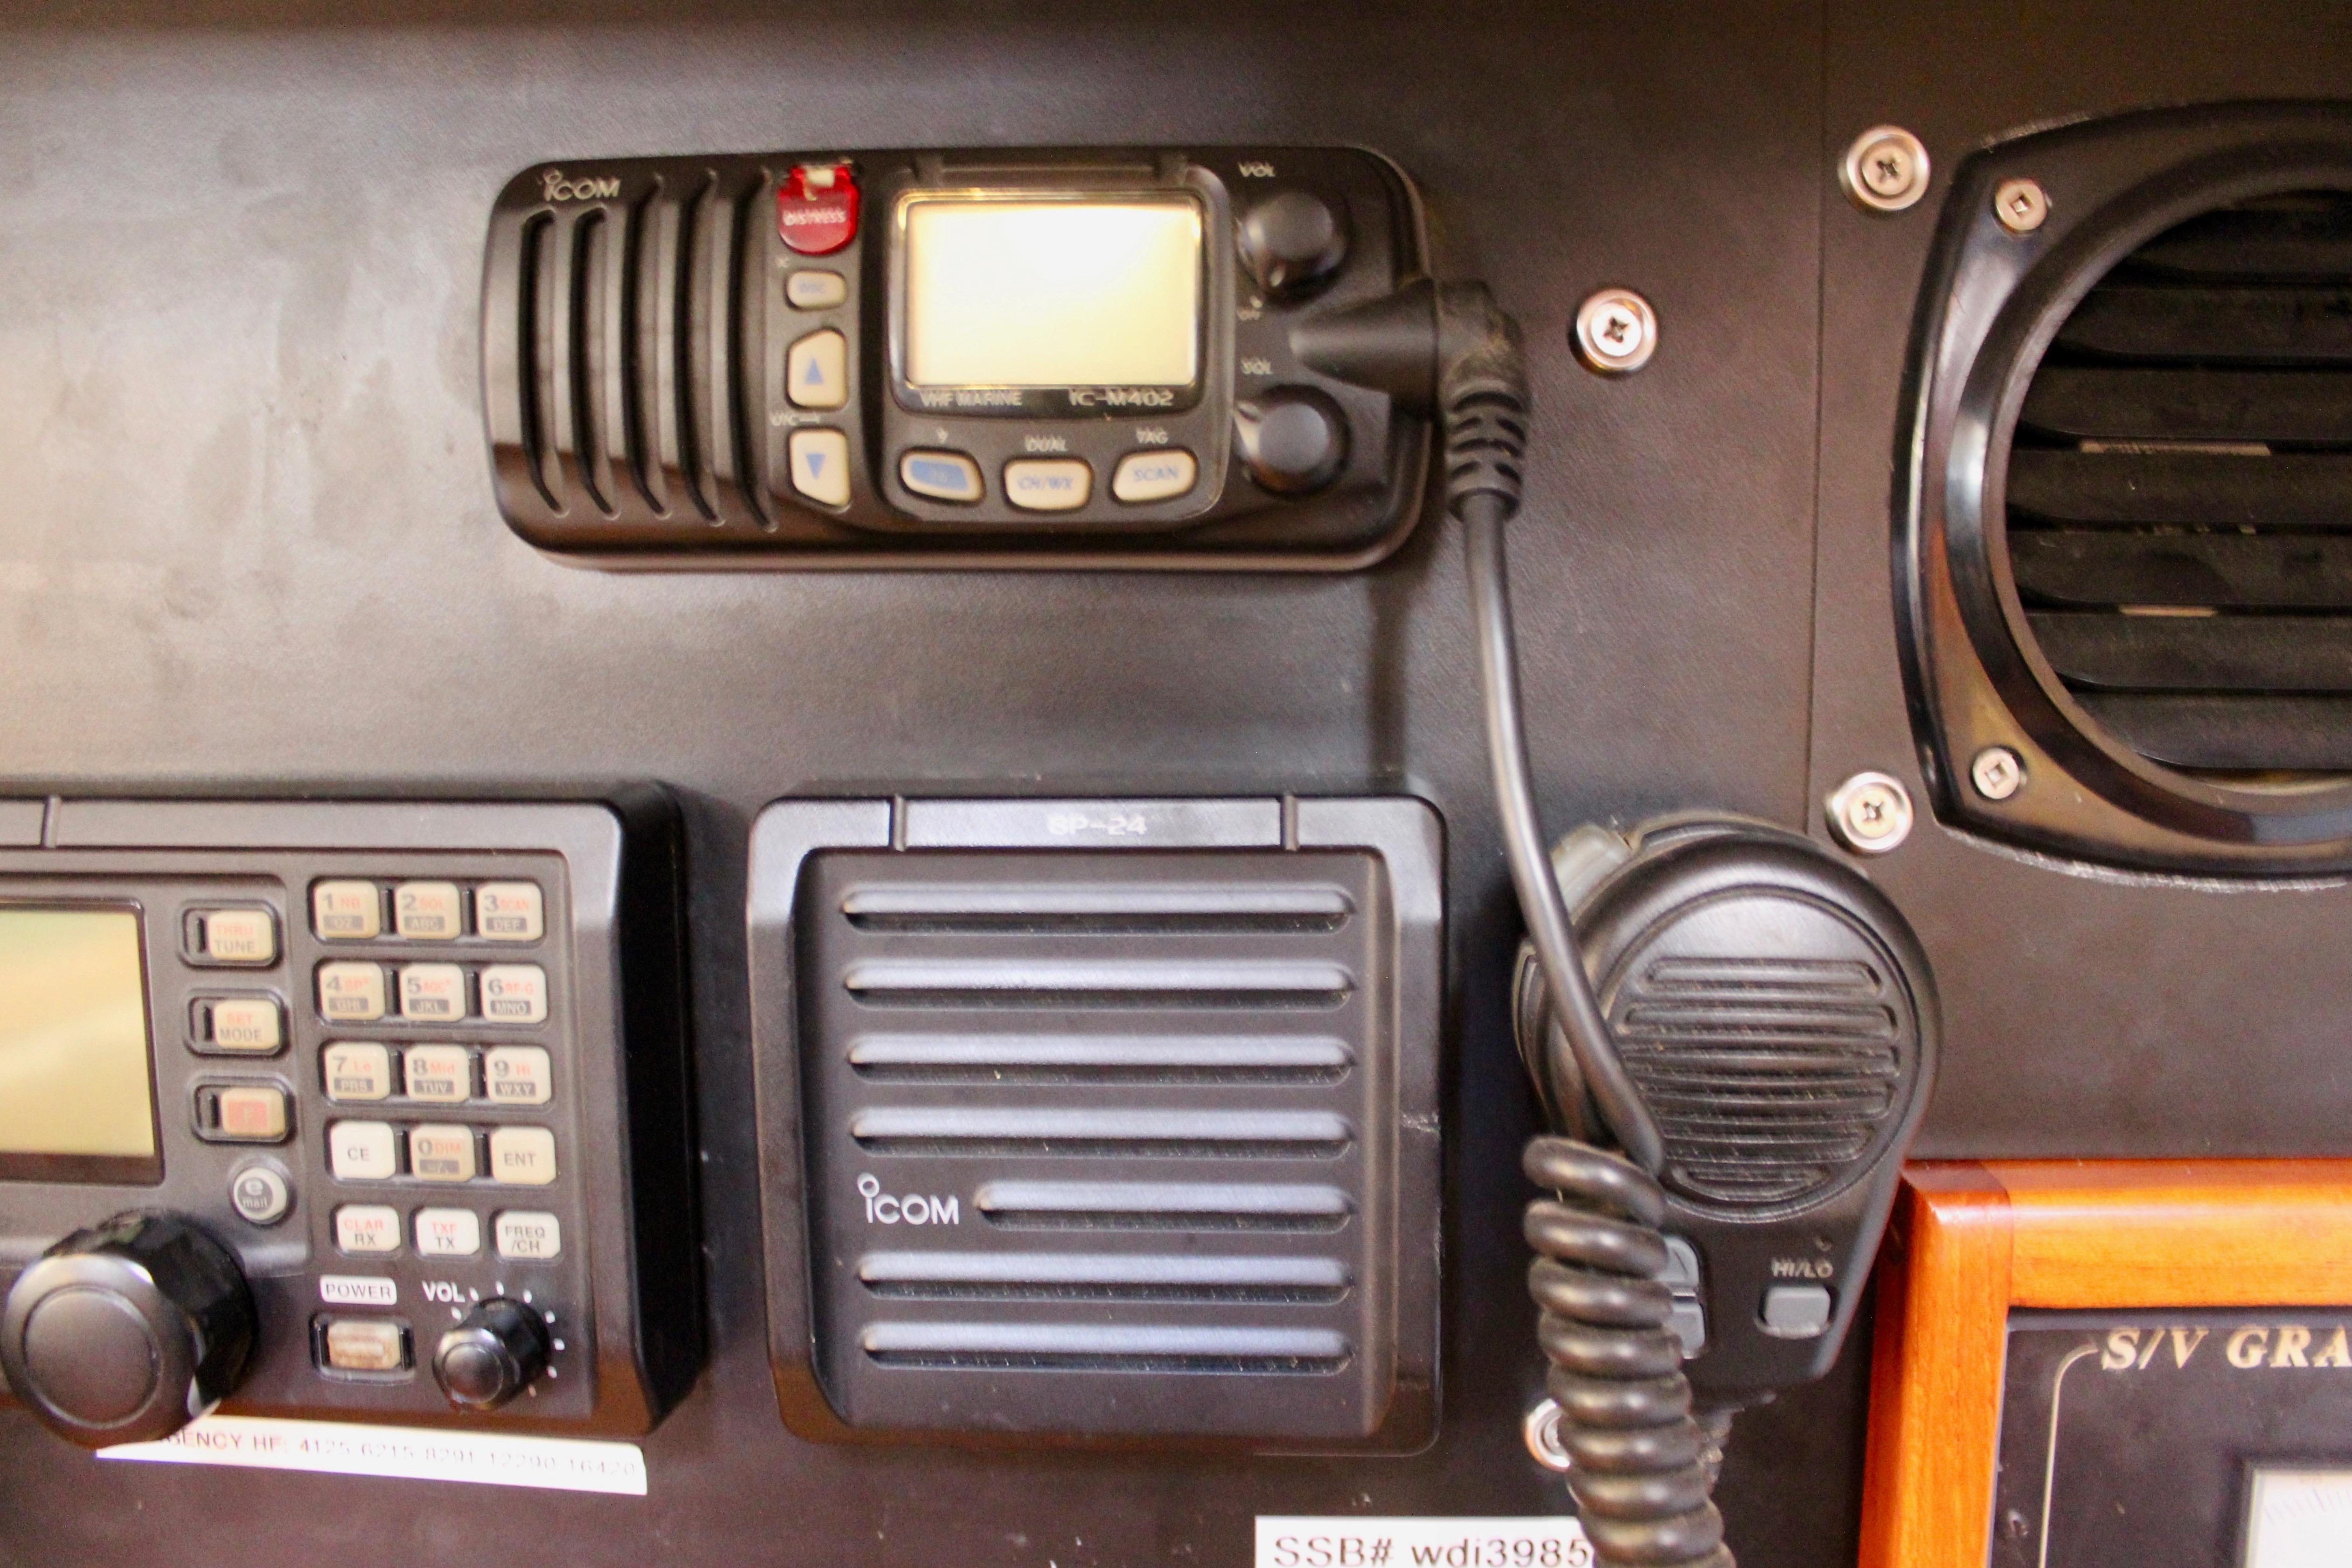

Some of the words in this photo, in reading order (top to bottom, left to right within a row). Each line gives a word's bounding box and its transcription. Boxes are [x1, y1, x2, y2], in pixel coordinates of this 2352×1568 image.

[782, 208, 846, 226] DISTRESS
[919, 390, 954, 406] VHF
[956, 390, 1022, 406] MARINE
[1068, 388, 1174, 406] IC-M402
[1025, 434, 1068, 452] DUAL
[1136, 426, 1168, 444] TAG
[1133, 465, 1179, 482] SCAN
[1017, 475, 1075, 490] CH/WX
[323, 894, 334, 911] 1
[340, 897, 361, 909] NB
[402, 894, 416, 912] 2
[484, 894, 499, 912] 3
[499, 897, 529, 911] SCAN
[215, 924, 254, 937] THRU
[410, 918, 438, 931] ABC
[493, 919, 520, 931] DEF
[215, 940, 256, 953] TUNE
[326, 976, 342, 992] 4
[407, 977, 422, 994] 5
[488, 978, 504, 995] 6
[336, 999, 362, 1011] GHI
[417, 1000, 442, 1013] JKL
[495, 1002, 527, 1014] MNO
[227, 1012, 253, 1024] SET
[220, 1029, 263, 1042] MODE
[333, 1055, 347, 1073] 7
[413, 1057, 428, 1075] 8
[431, 1060, 456, 1075] Mid
[494, 1059, 510, 1078] 9
[340, 1079, 367, 1092] PRS
[421, 1081, 448, 1094] TUV
[500, 1082, 531, 1096] WXY
[347, 1147, 370, 1162] CE
[418, 1139, 433, 1157] 0
[435, 1141, 462, 1156] DIM
[504, 1152, 537, 1167] ENT
[245, 1179, 263, 1195] e
[243, 1196, 268, 1208] mail
[343, 1217, 384, 1232] CLAR
[431, 1221, 458, 1235] TXF
[505, 1225, 546, 1240] FREQ
[354, 1232, 376, 1247] RX
[436, 1236, 455, 1251] TX
[510, 1238, 541, 1254] /CH
[1771, 1258, 1833, 1278] HI/LO
[326, 1284, 391, 1299] POWER
[422, 1281, 465, 1303] VOL
[2101, 1325, 2209, 1370] S/V
[489, 1451, 555, 1471] 12290
[569, 1457, 635, 1477] 16420
[1274, 1536, 1395, 1568] SSB#
[1411, 1536, 1590, 1568] wdi3985
